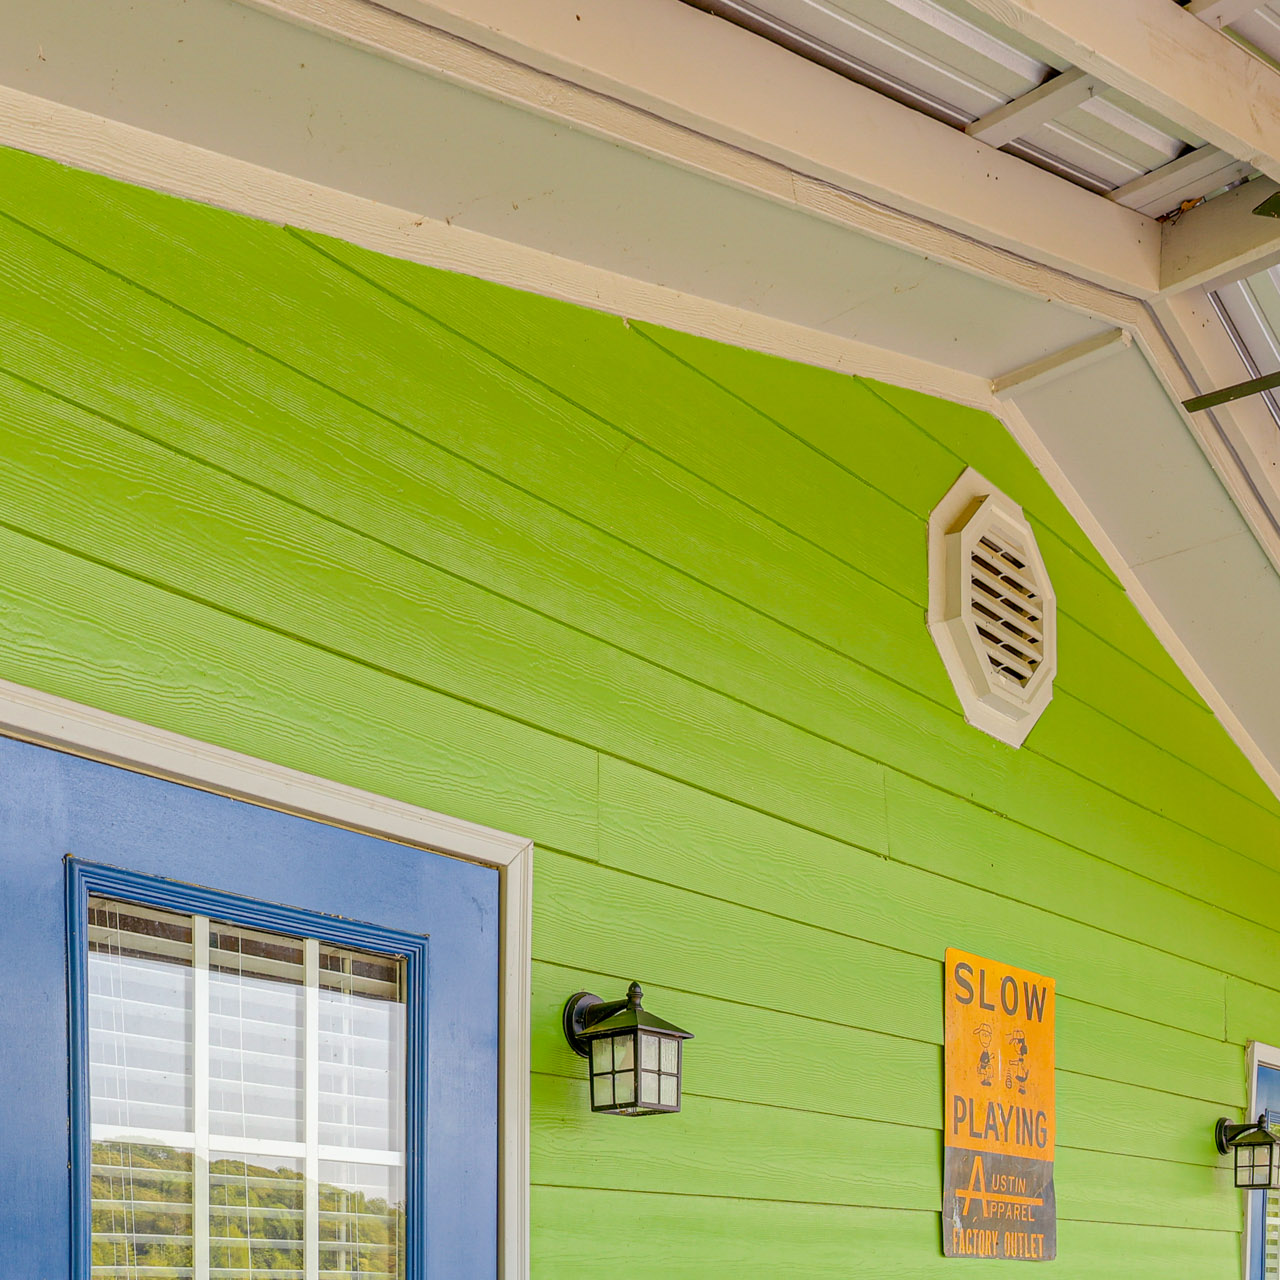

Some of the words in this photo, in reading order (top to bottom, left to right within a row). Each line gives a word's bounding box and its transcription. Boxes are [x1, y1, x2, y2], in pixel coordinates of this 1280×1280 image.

[954, 962, 1047, 1023] SLOW
[953, 1095, 1048, 1148] PLAYING
[952, 1227, 998, 1256] FACTORY
[1004, 1231, 1045, 1259] OUTLET
